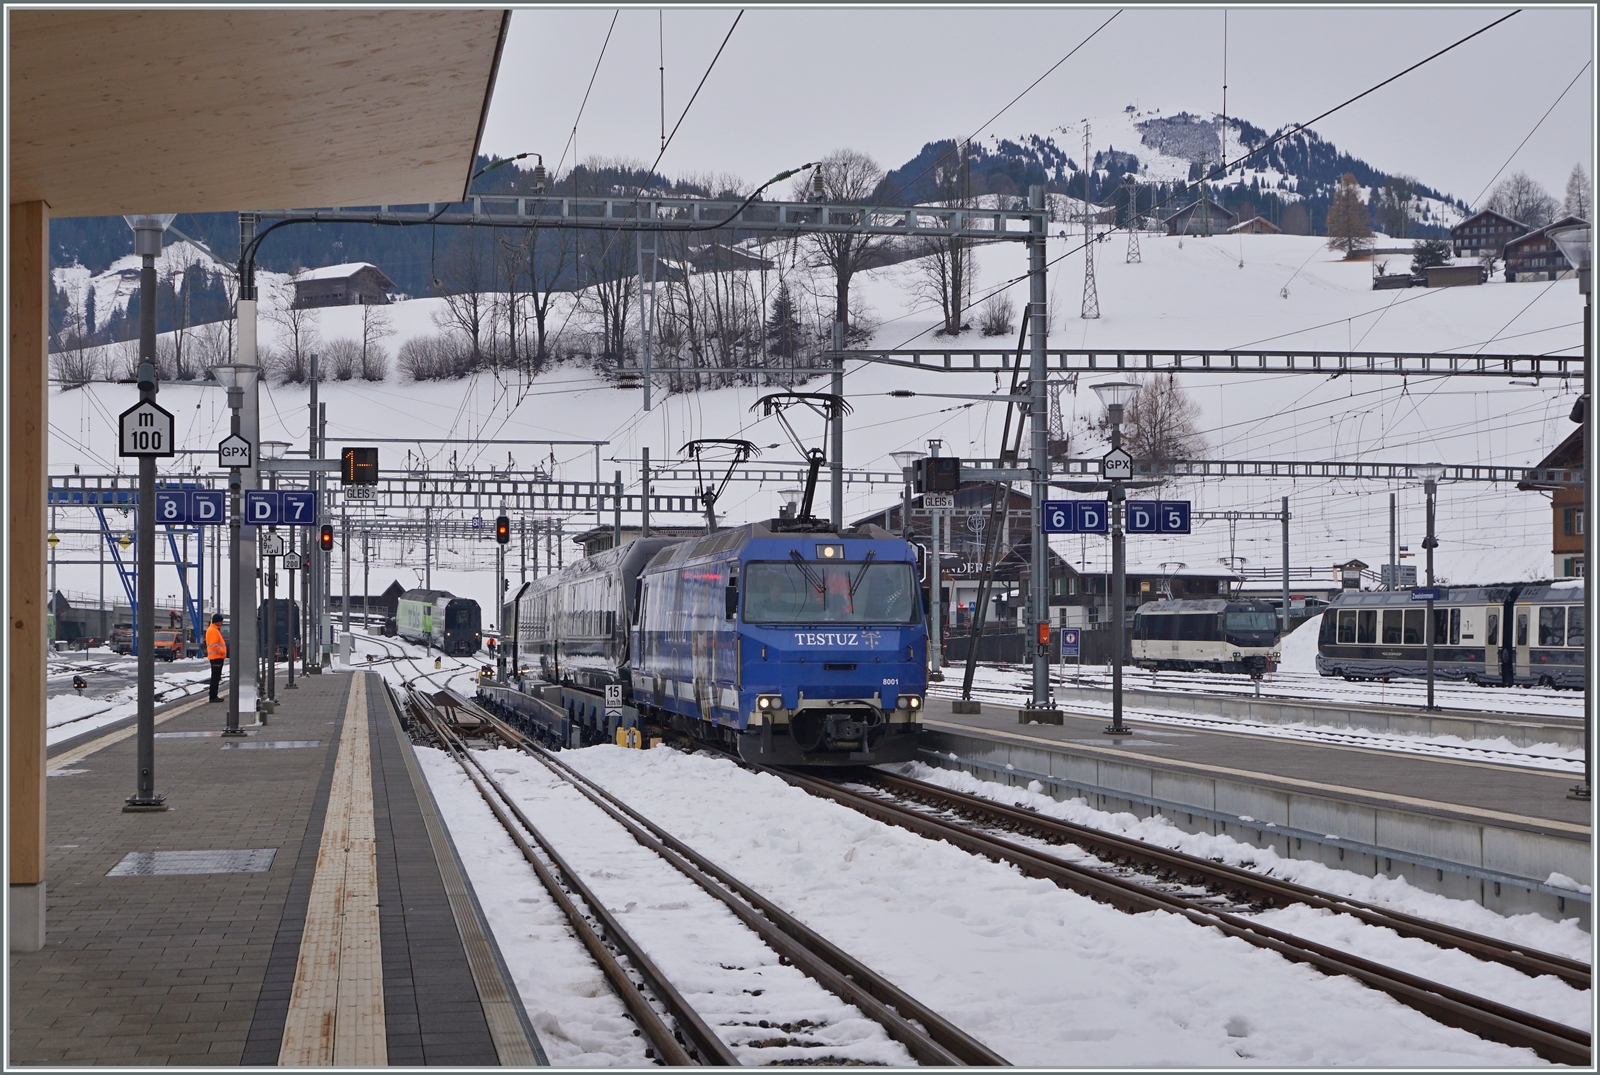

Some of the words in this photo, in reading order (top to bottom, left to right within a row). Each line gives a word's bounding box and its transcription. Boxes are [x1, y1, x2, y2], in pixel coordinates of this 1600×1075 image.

[138, 412, 154, 427] m
[132, 431, 162, 450] 100
[222, 447, 248, 457] GPX
[1106, 459, 1130, 470] GPX
[347, 489, 370, 498] GLEIS
[925, 497, 947, 506] GLEIS
[164, 501, 177, 518] 8
[200, 502, 216, 518] D
[256, 502, 271, 519] D
[292, 502, 305, 519] 7
[1052, 510, 1065, 528] 6
[1085, 511, 1099, 528] D
[1136, 511, 1150, 528] D
[1168, 512, 1181, 528] 5
[795, 633, 859, 646] TESTUZ
[608, 686, 619, 698] 15
